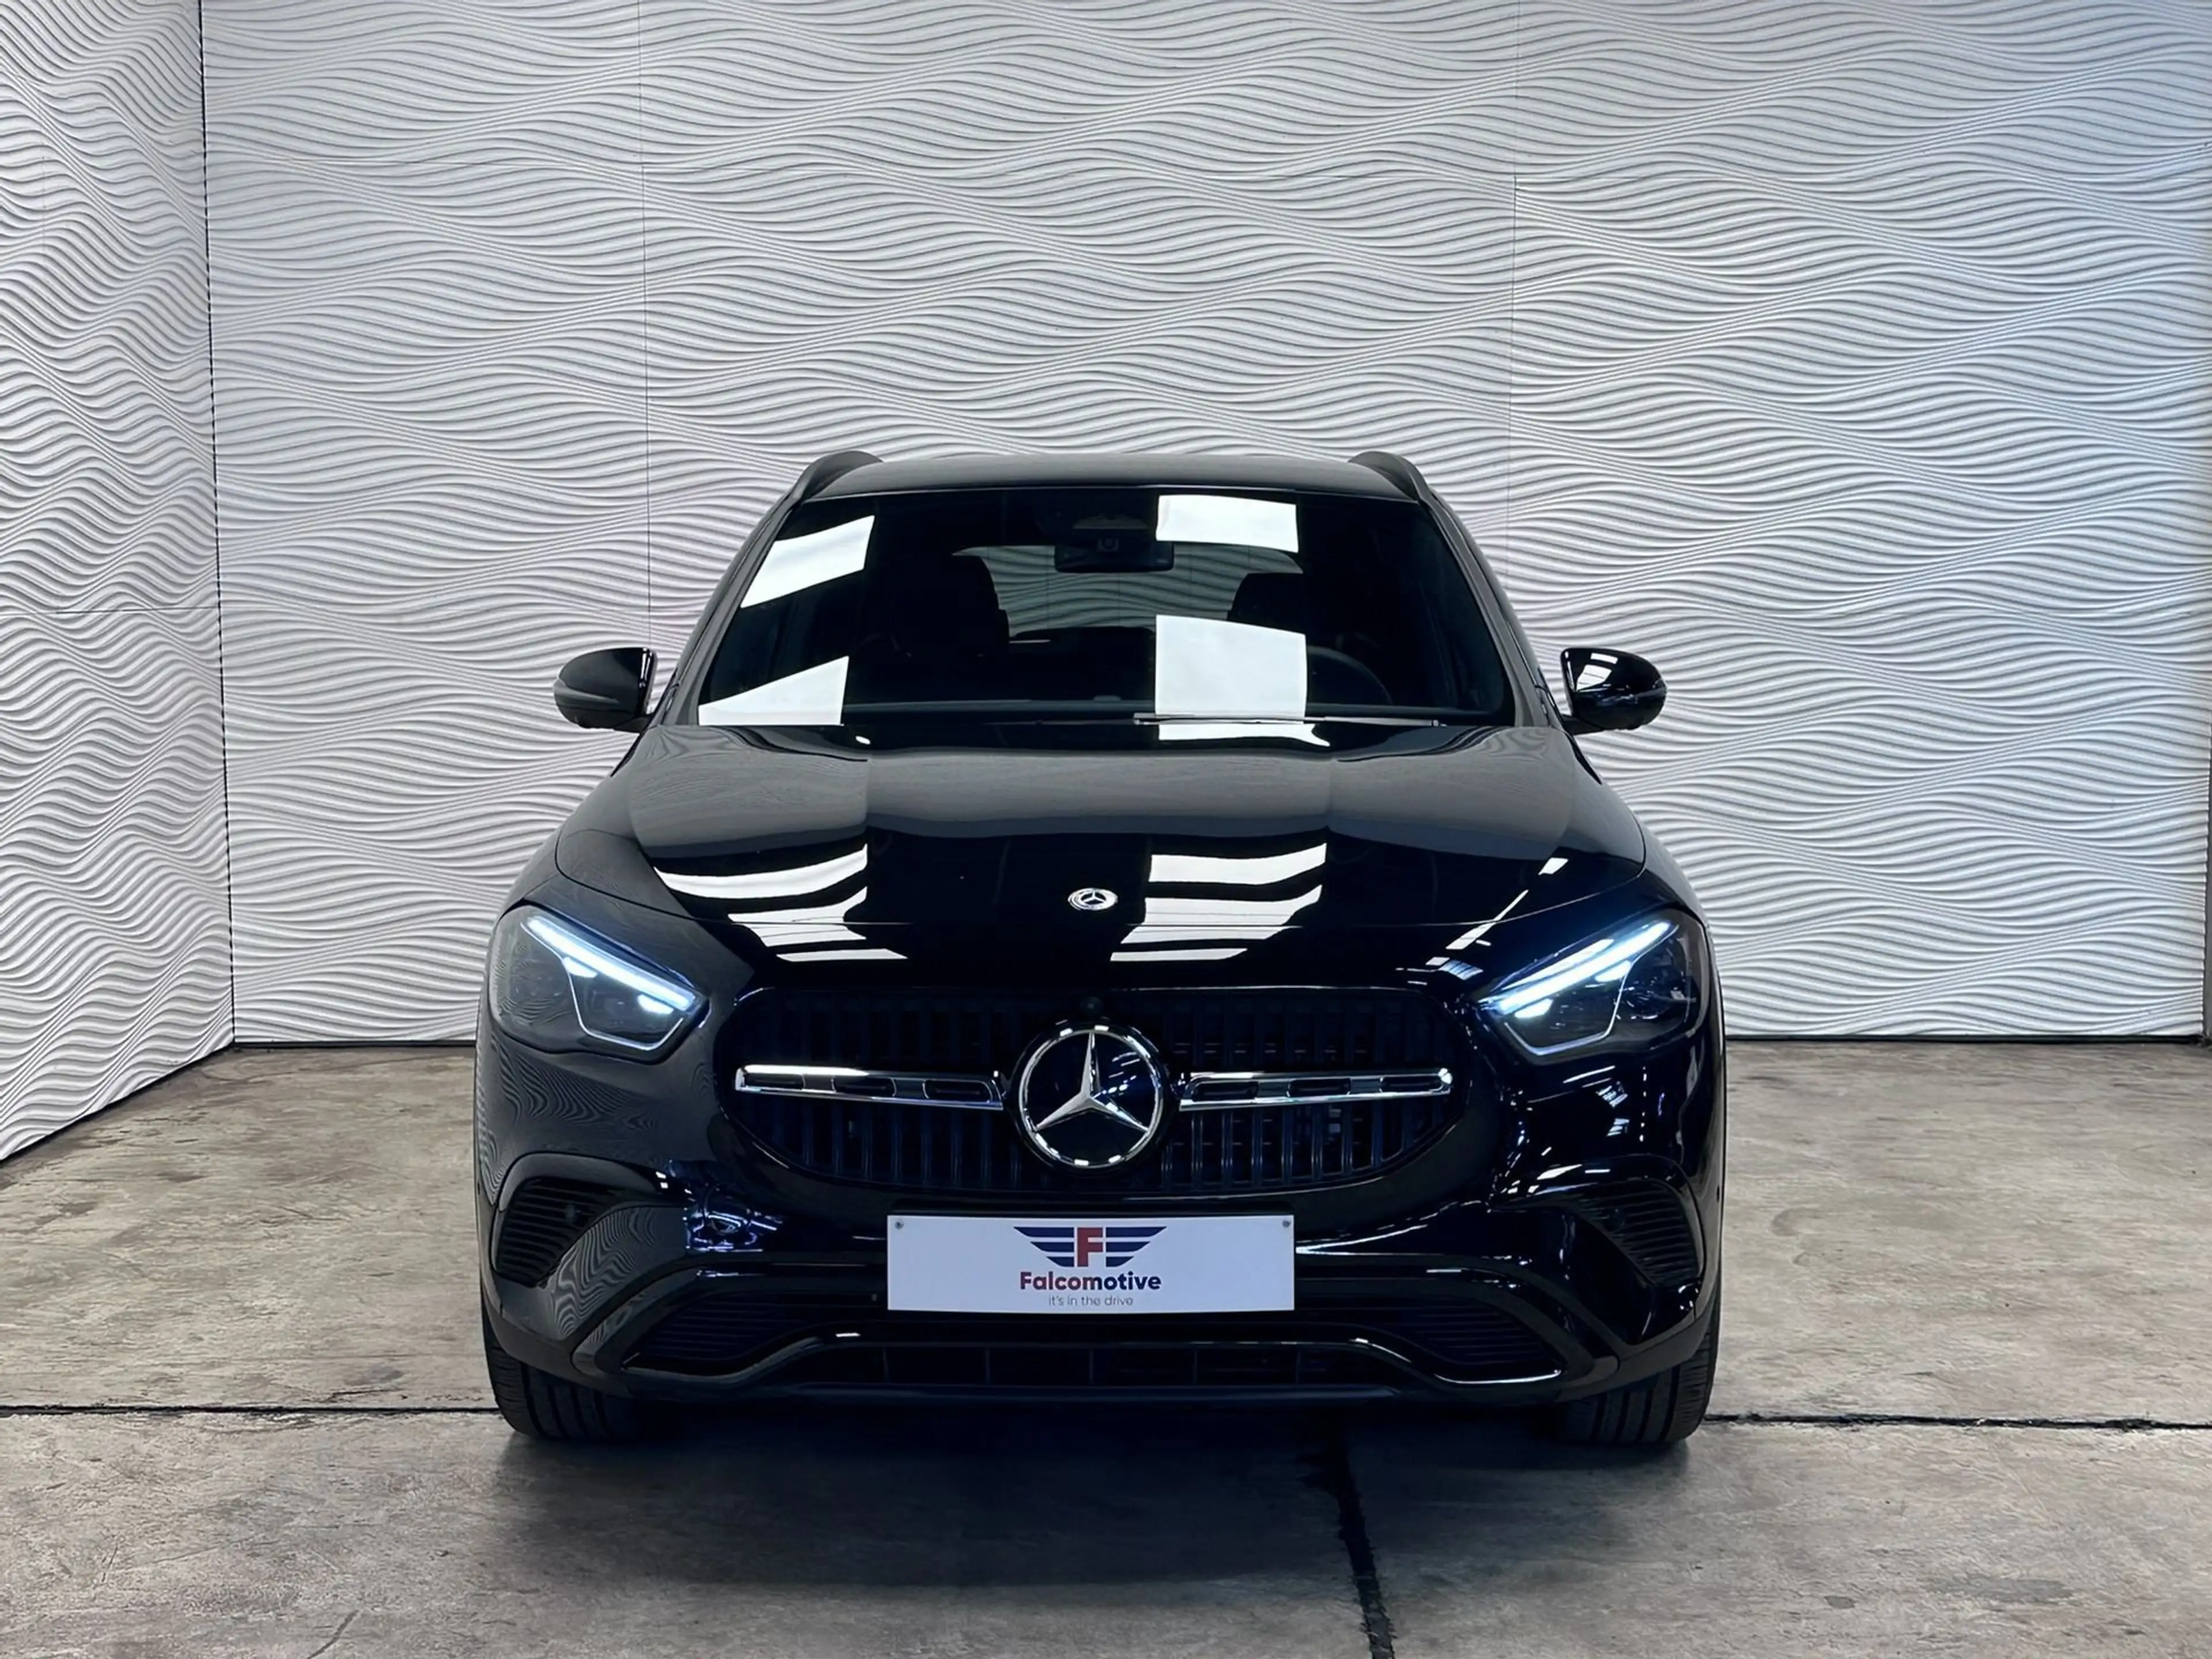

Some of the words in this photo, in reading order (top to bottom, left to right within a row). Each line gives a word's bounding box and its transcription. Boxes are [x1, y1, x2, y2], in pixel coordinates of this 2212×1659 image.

[1077, 1227, 1104, 1267] F
[1020, 1270, 1162, 1290] Falcomotive
[1048, 1294, 1065, 1306] it's
[1067, 1294, 1078, 1306] in
[1081, 1294, 1101, 1306] the
[1104, 1294, 1134, 1306] drive
